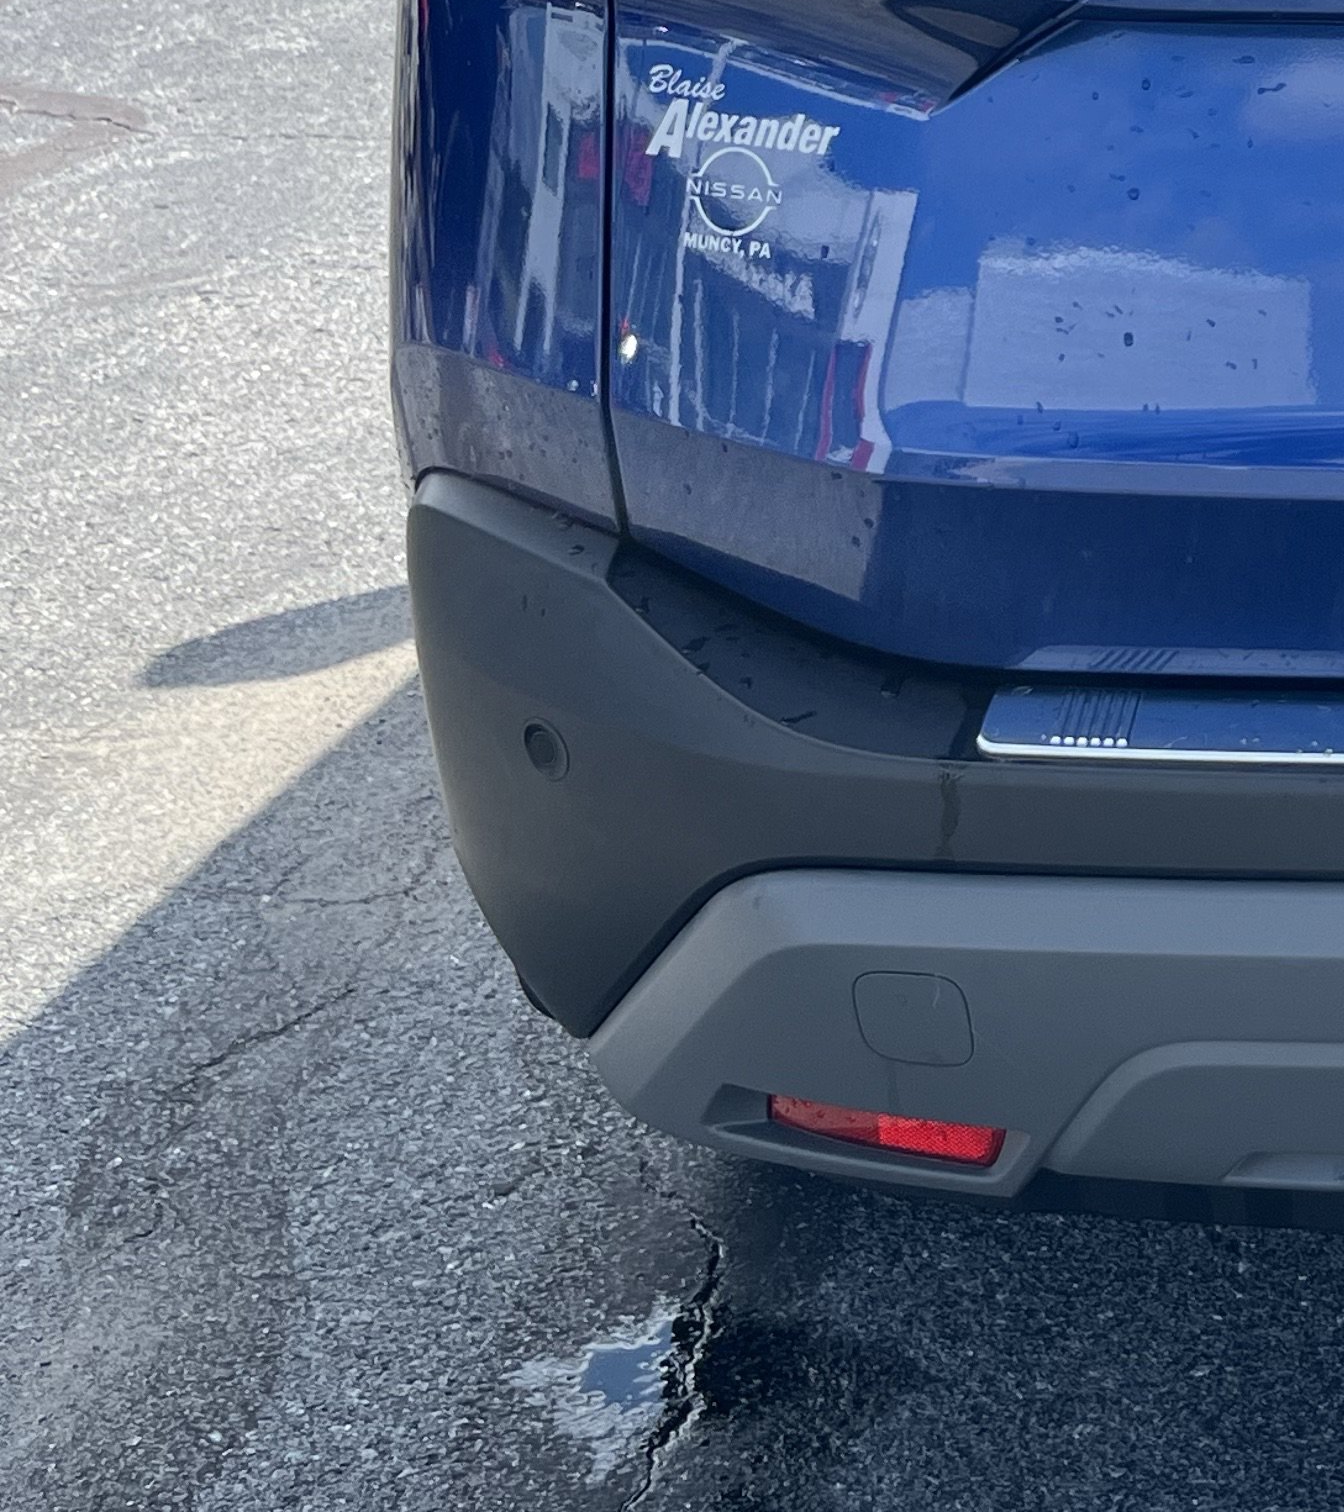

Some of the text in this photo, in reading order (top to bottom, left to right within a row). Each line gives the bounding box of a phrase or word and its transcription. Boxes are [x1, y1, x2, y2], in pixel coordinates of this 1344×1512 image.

[649, 63, 727, 101] Blaise
[645, 98, 841, 159] Alexander
[686, 178, 783, 205] NISSAN
[683, 231, 772, 259] MUNCY, PA
